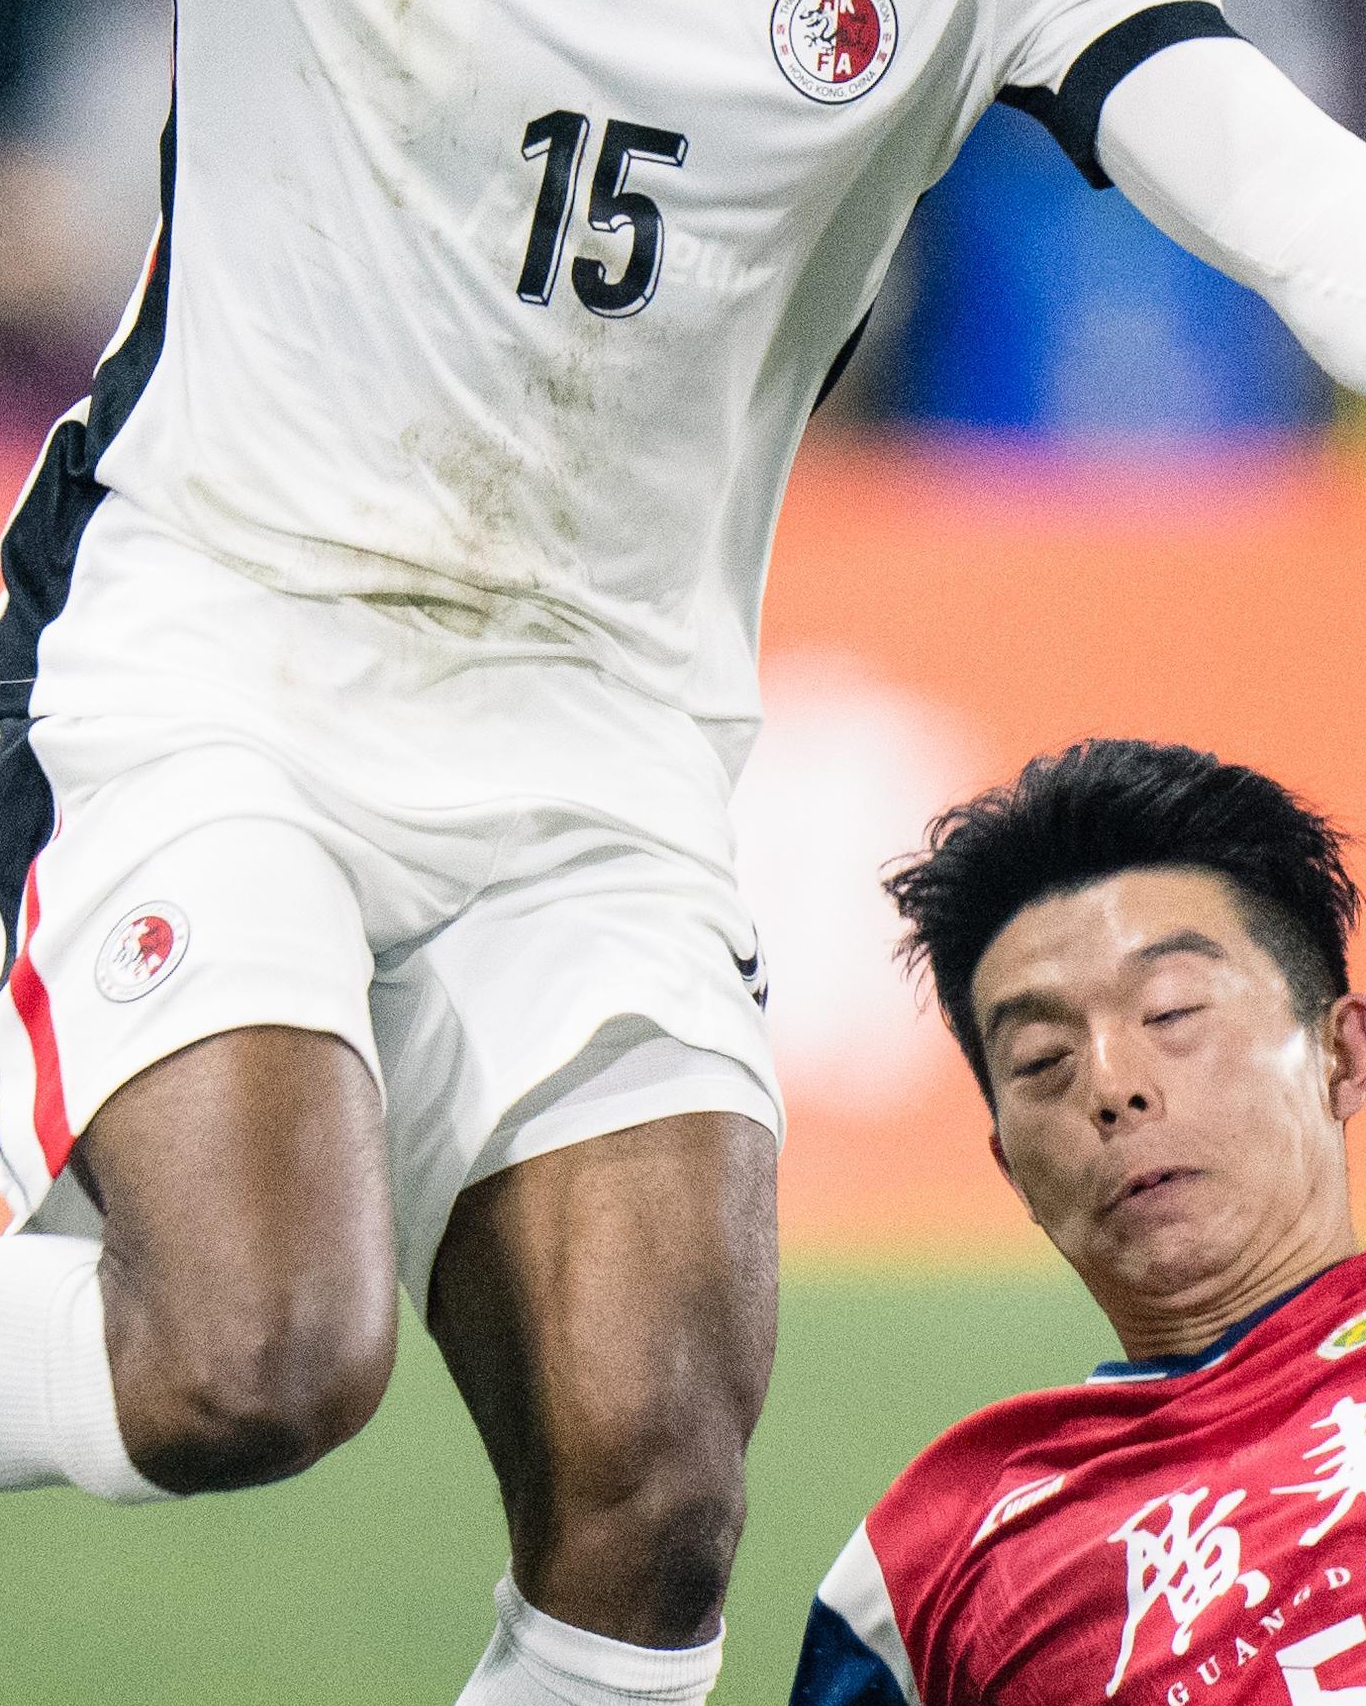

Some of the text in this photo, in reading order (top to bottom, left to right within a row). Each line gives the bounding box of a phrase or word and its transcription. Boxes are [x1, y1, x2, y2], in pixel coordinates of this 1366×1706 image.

[817, 52, 853, 75] FA
[788, 64, 814, 91] HONG
[848, 70, 876, 94] CHINA
[516, 109, 689, 319] 15
